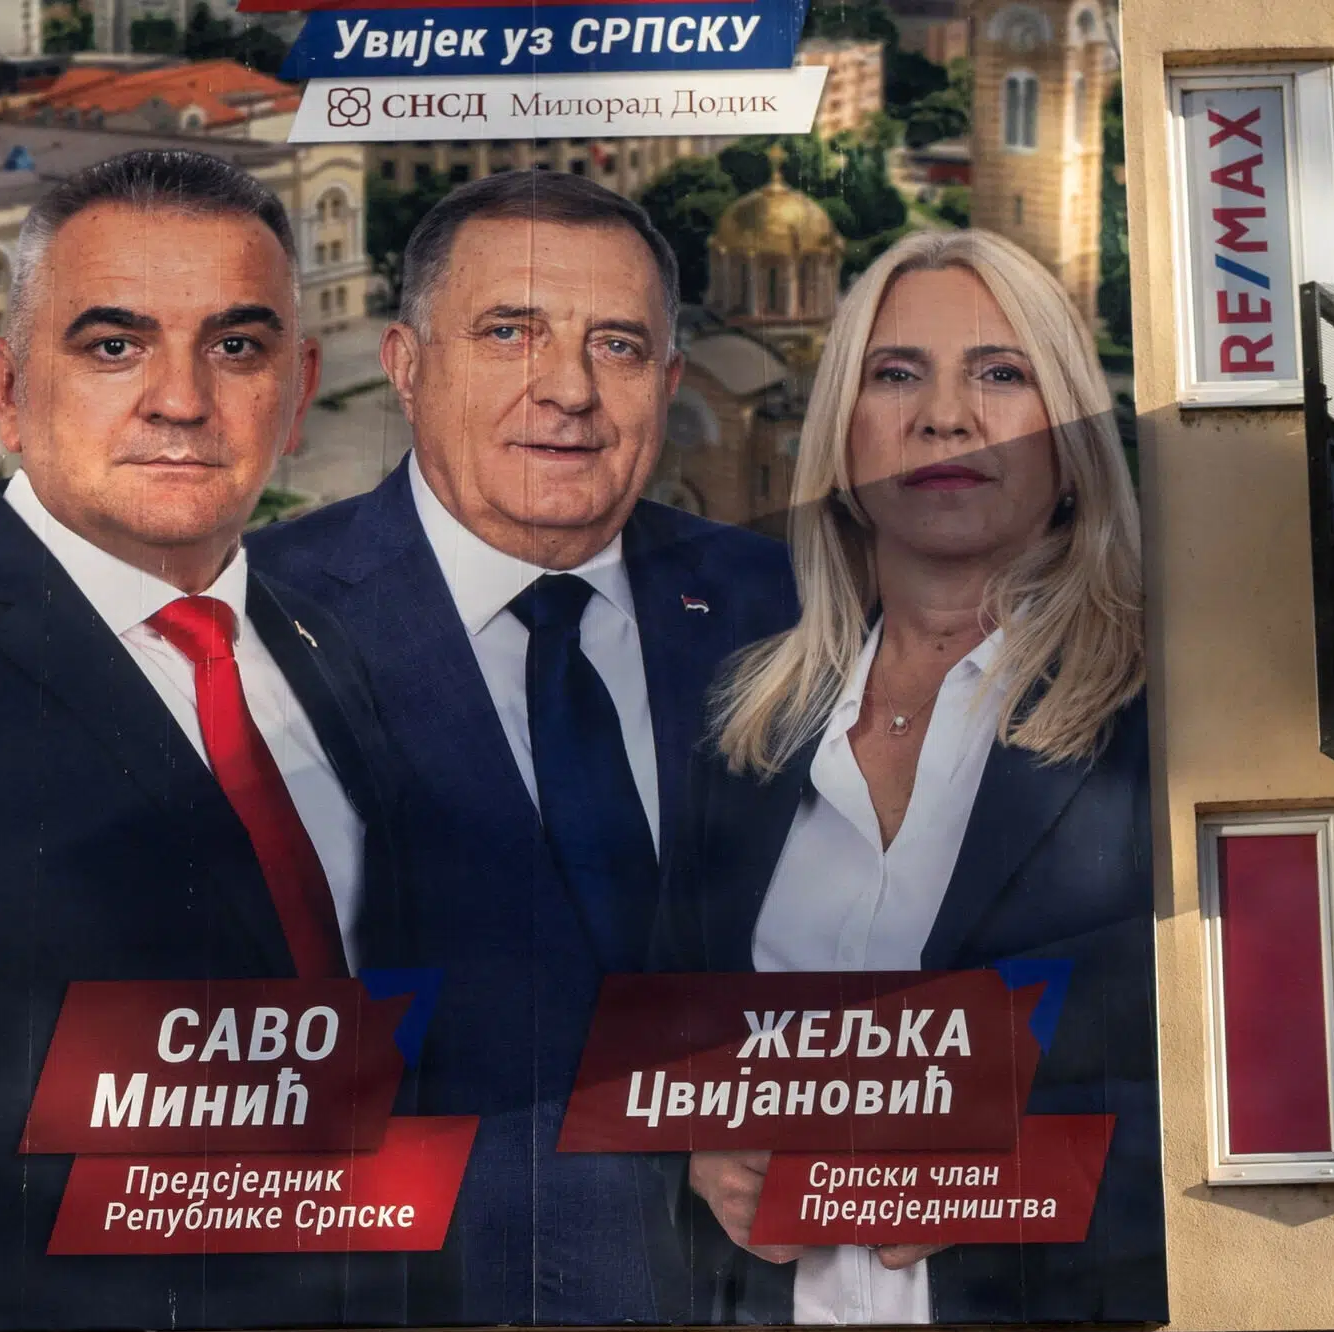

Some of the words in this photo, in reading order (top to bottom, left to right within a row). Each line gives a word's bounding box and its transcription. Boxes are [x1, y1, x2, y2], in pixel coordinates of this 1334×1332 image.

[333, 19, 487, 66] Увијек
[501, 28, 552, 64] уз
[570, 16, 761, 56] СРПСКУ
[381, 92, 487, 122] СНСД
[510, 91, 662, 119] Милорад
[671, 88, 778, 117] Додик
[1207, 107, 1274, 374] RE/MAX
[157, 1006, 339, 1063] САВО
[736, 1009, 971, 1059] ЖЕЉКА
[90, 1067, 309, 1128] Минић
[626, 1065, 953, 1128] Цвијановић
[125, 1163, 344, 1201] Предсједник
[809, 1161, 917, 1191] Српски
[930, 1164, 999, 1186] члан
[104, 1199, 283, 1237] Републике
[294, 1199, 415, 1235] Српске
[800, 1193, 1057, 1226] Предсједништва
